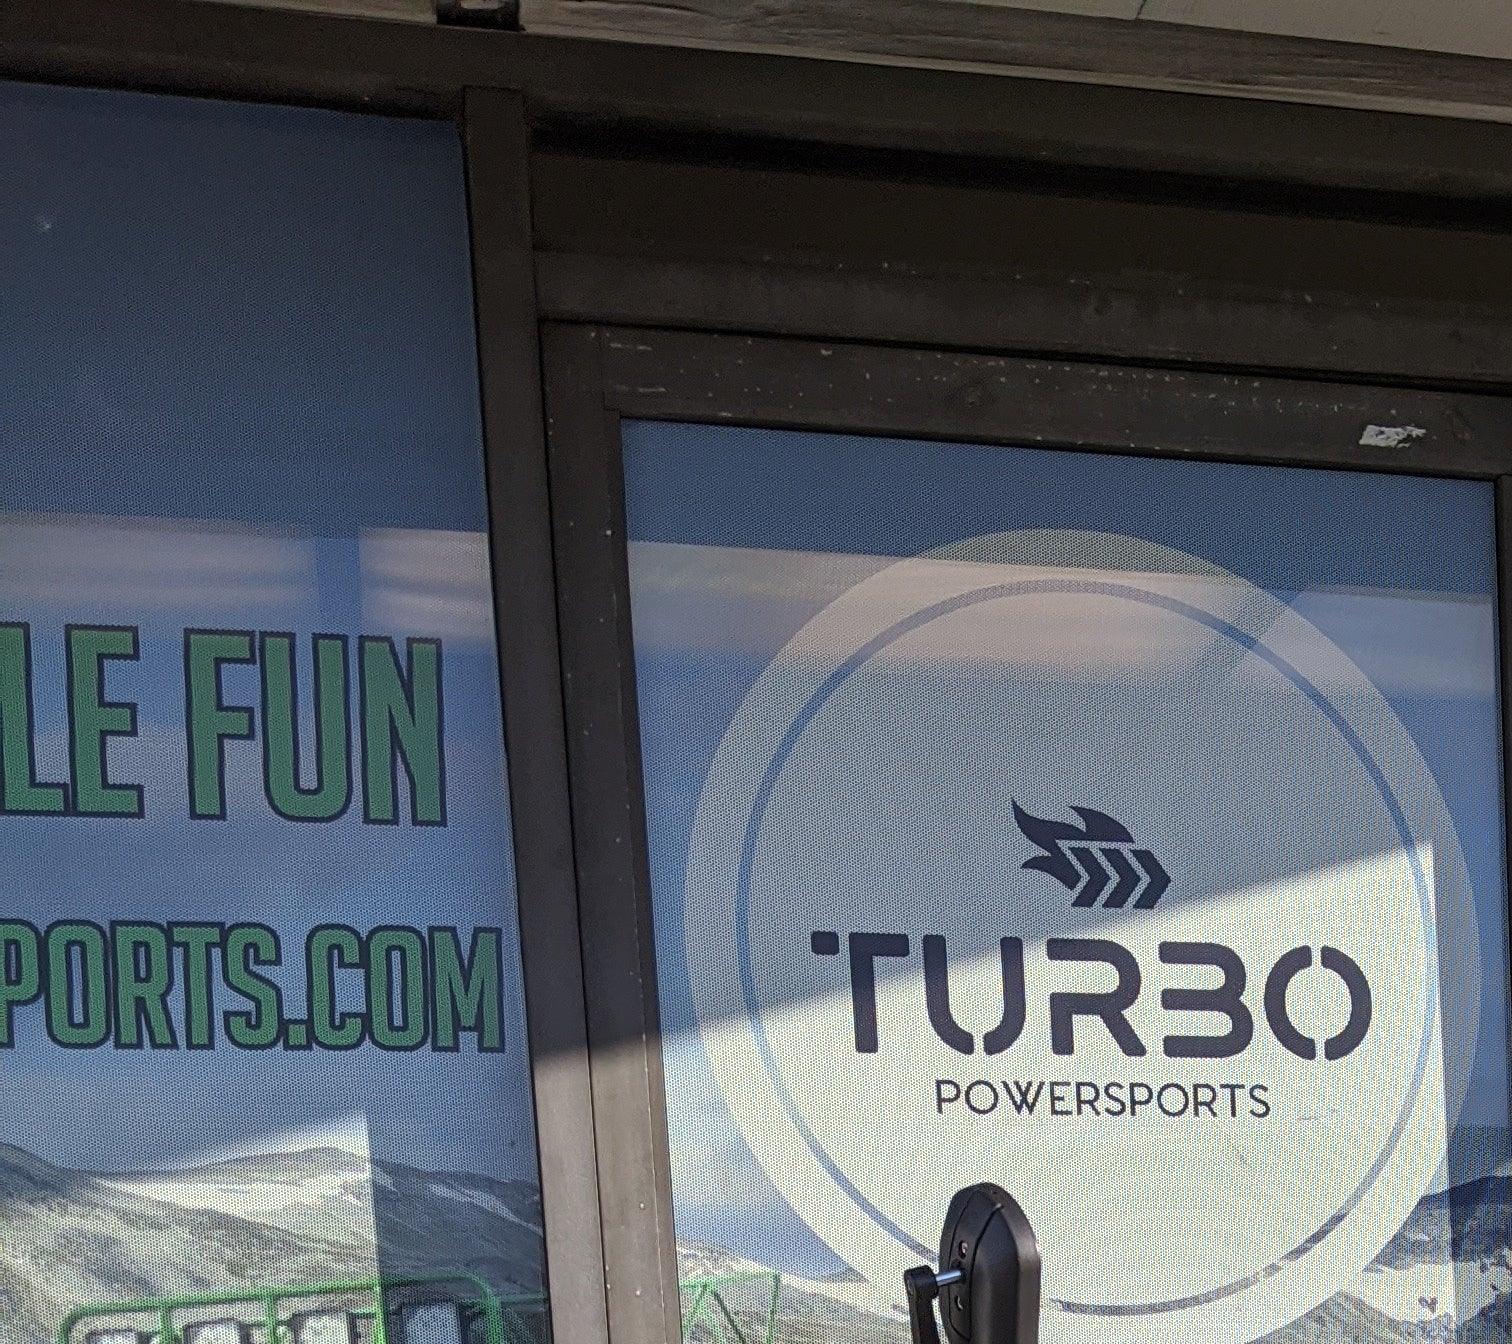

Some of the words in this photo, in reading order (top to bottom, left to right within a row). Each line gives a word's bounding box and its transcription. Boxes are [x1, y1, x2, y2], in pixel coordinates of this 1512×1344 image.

[183, 627, 448, 828] FUN
[0, 919, 506, 1055] PORTS.COM
[810, 930, 1373, 1062] TURBO
[935, 1079, 1271, 1119] POWERSPORTS
